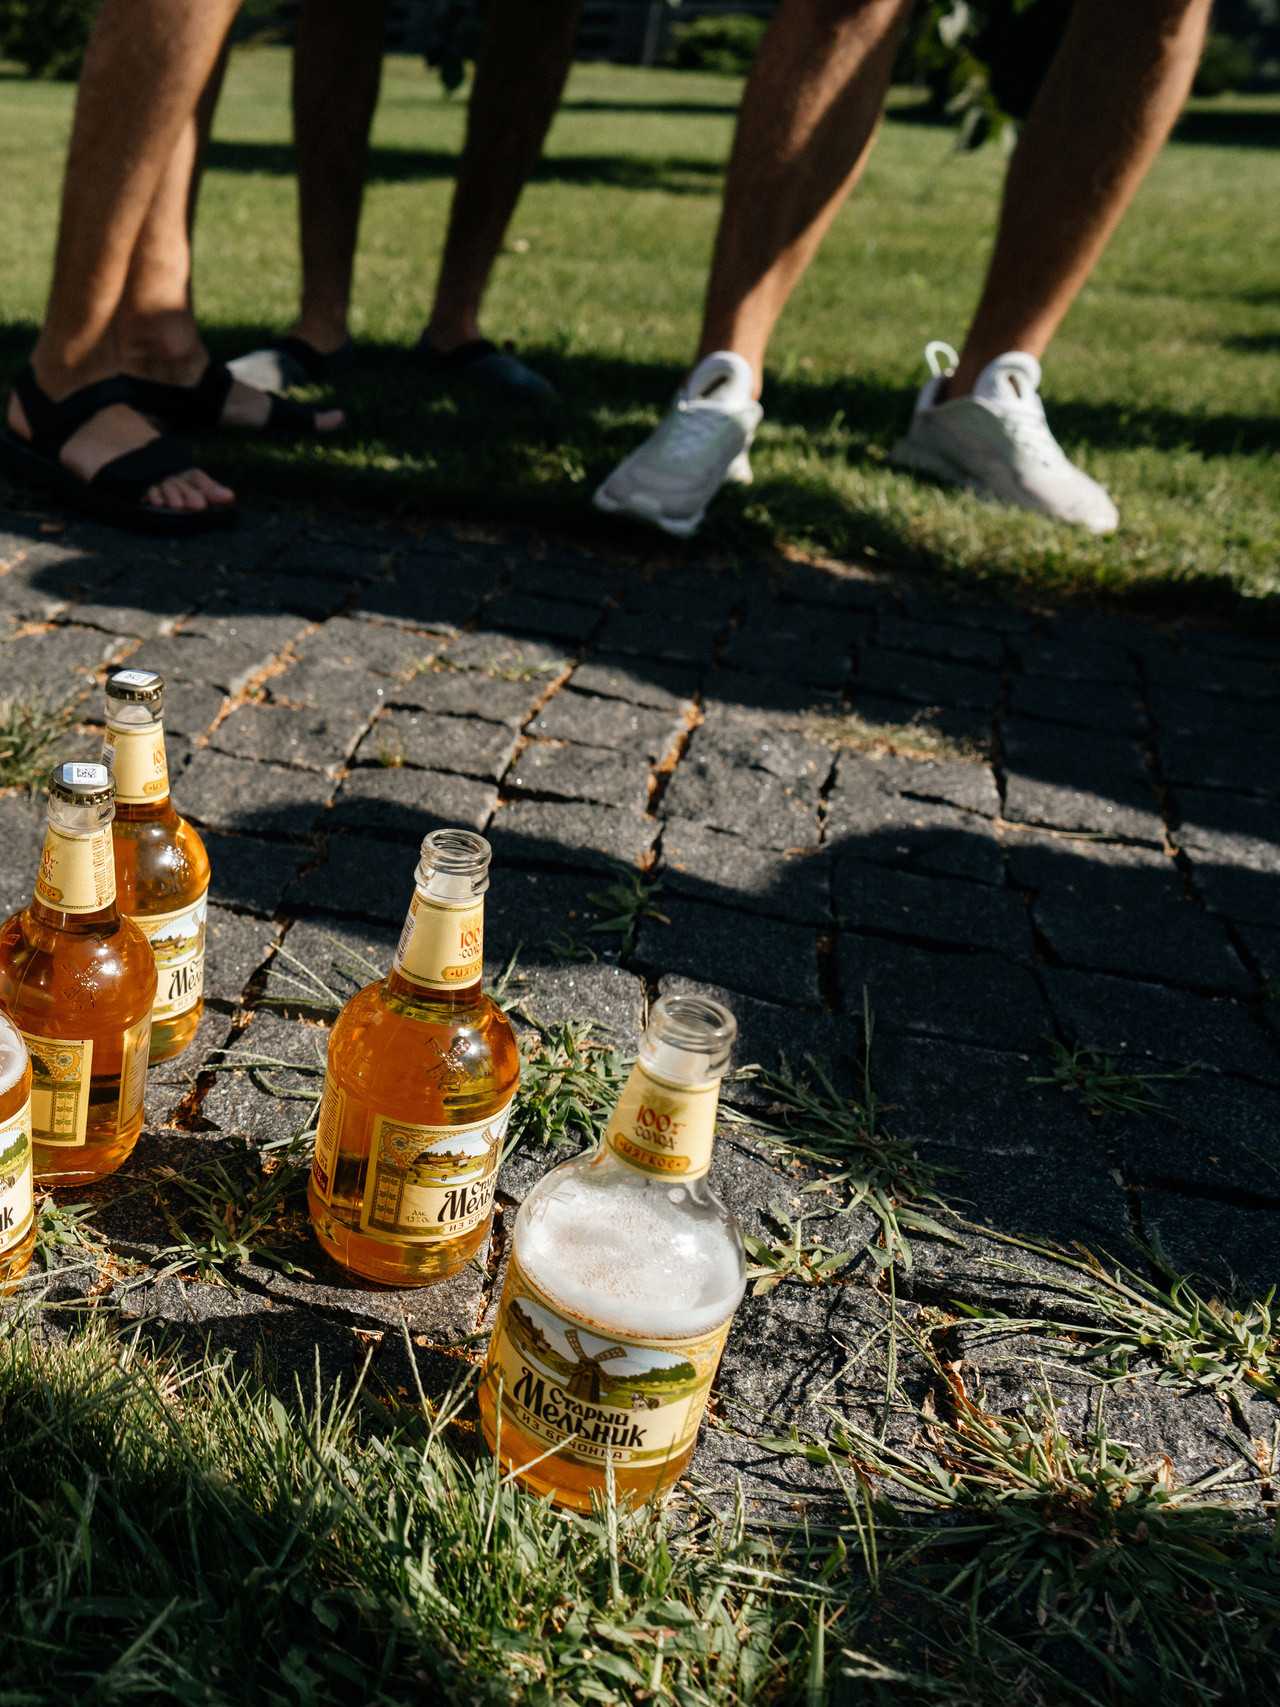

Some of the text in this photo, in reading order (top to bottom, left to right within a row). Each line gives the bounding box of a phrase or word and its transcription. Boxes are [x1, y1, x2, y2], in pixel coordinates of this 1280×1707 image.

[39, 882, 52, 896] КОЕ
[634, 1126, 674, 1151] СОЛОД
[622, 1143, 675, 1169] МЯГКОЕ
[449, 1222, 464, 1232] ИЗ
[513, 1366, 647, 1448] Мельник
[549, 1387, 630, 1426] Старый
[522, 1413, 540, 1430] ИЗ
